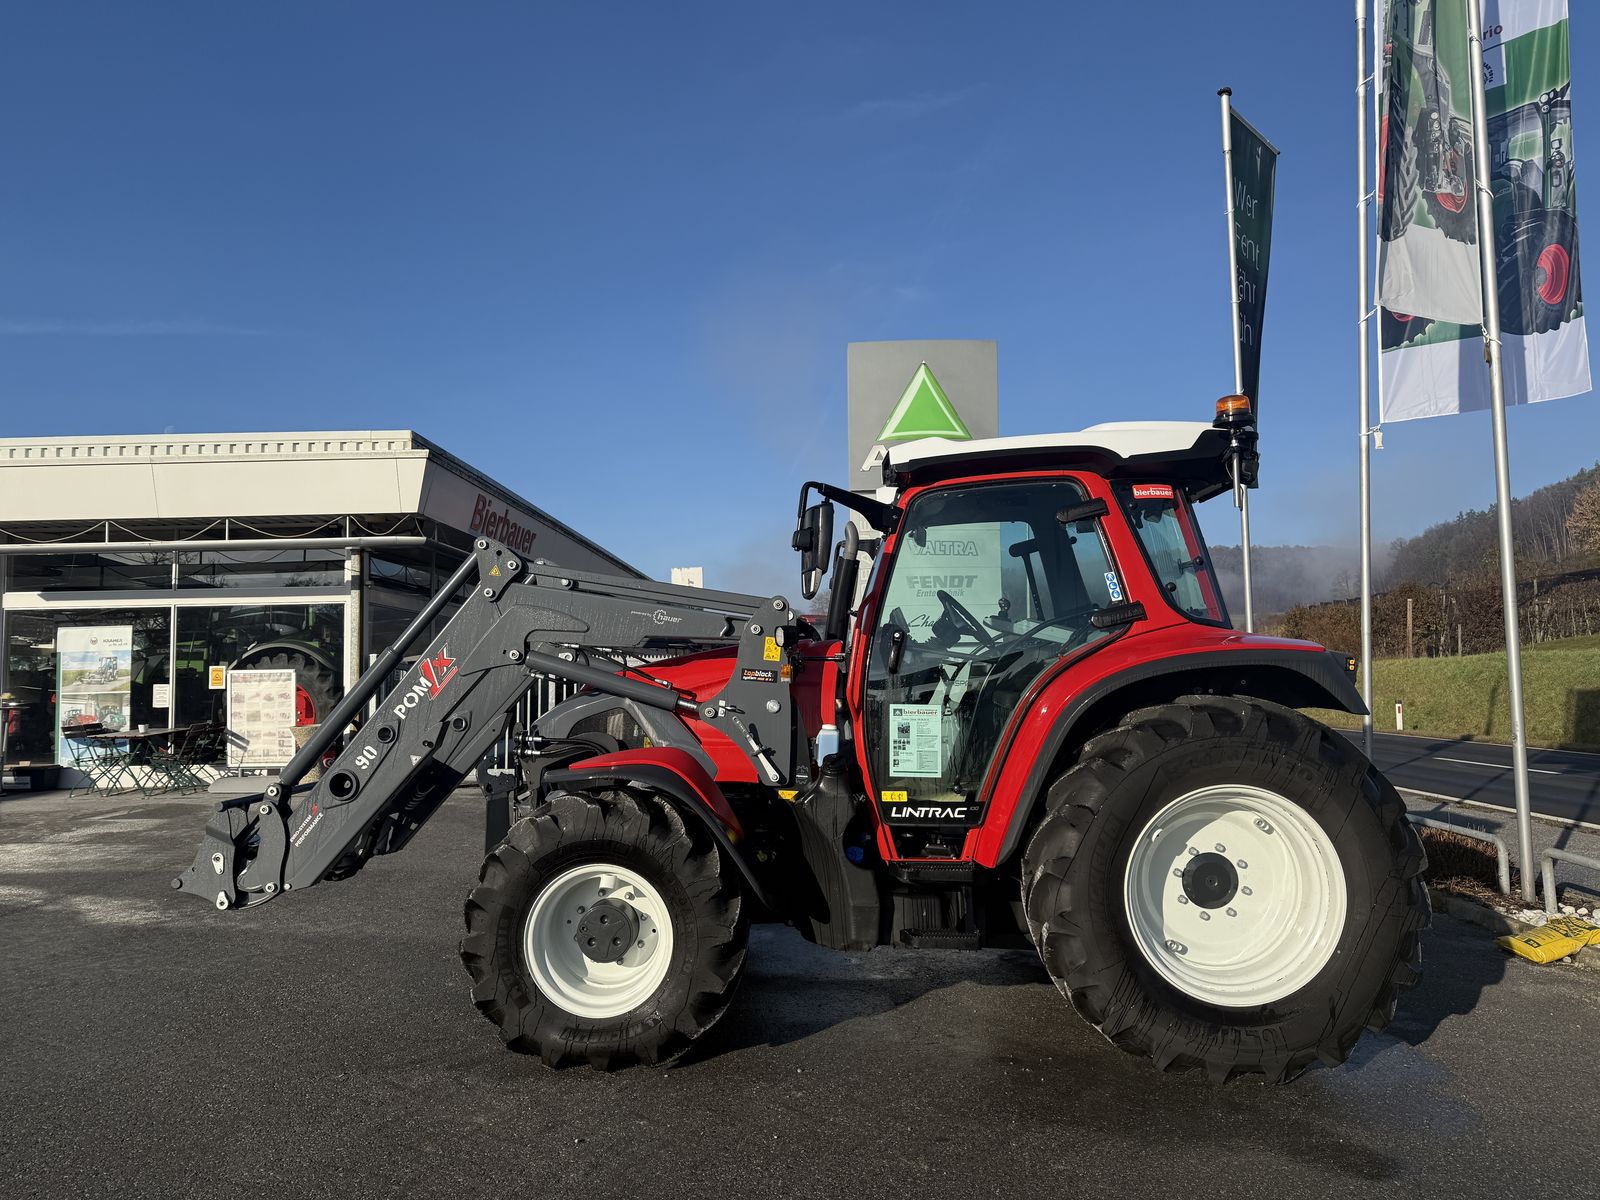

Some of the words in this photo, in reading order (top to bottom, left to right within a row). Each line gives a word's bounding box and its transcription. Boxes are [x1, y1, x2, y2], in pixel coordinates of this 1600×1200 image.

[1483, 25, 1504, 40] rio
[1133, 487, 1173, 496] bierbauer
[470, 493, 537, 554] Bierbauer
[906, 575, 978, 589] FENDT
[743, 669, 773, 678] topblock
[355, 745, 378, 770] 90
[891, 806, 968, 818] LINTRAC
[294, 812, 324, 848] PERFORMANCE
